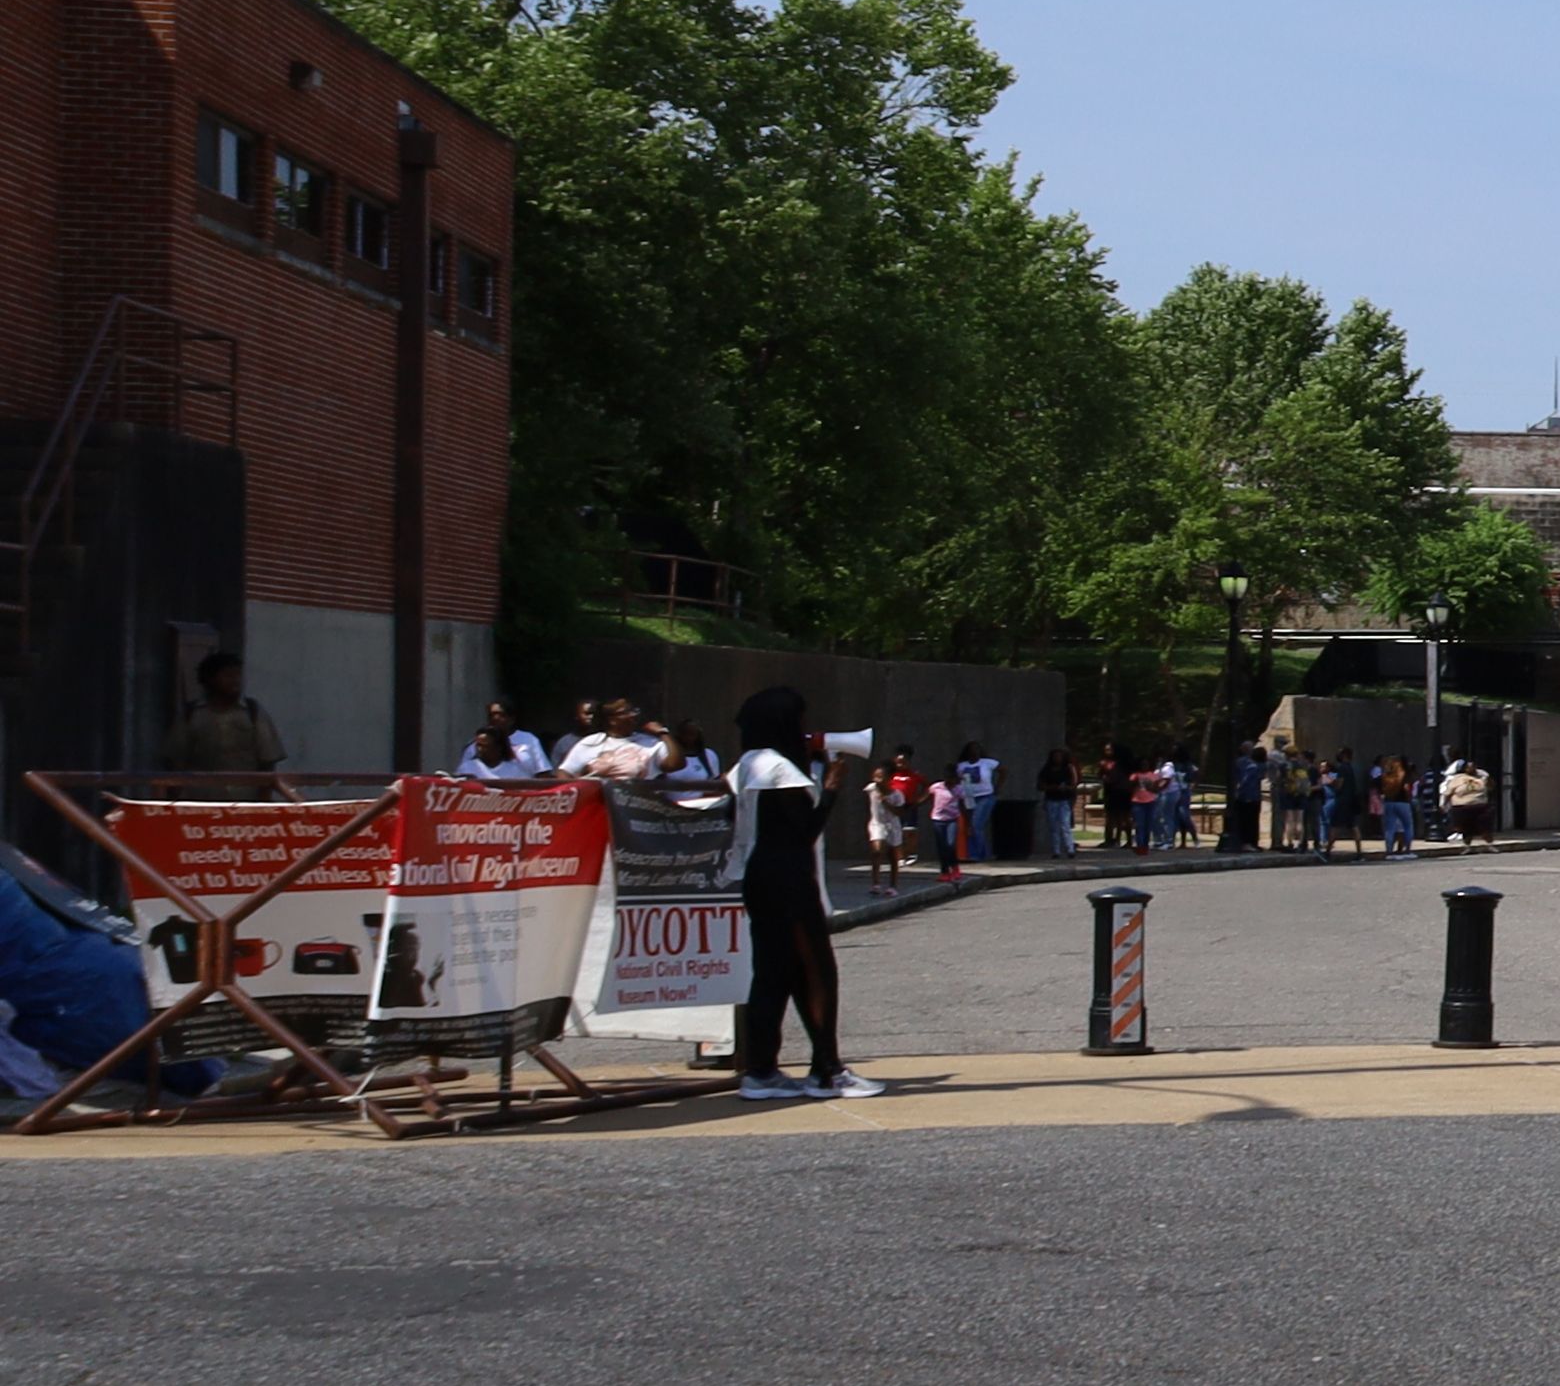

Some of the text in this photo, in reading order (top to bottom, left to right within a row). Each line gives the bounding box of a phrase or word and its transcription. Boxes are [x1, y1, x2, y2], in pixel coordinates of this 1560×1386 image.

[457, 789, 522, 812] million
[182, 823, 205, 839] to
[209, 821, 287, 842] support
[289, 821, 325, 837] the
[436, 817, 553, 852] renovating the
[179, 845, 243, 867] needy
[248, 843, 288, 862] and
[205, 872, 228, 888] to
[230, 869, 270, 888] buy
[389, 855, 448, 886] ational
[614, 904, 745, 960] YCOTT
[656, 961, 684, 978] Civil
[686, 959, 731, 980] Rights
